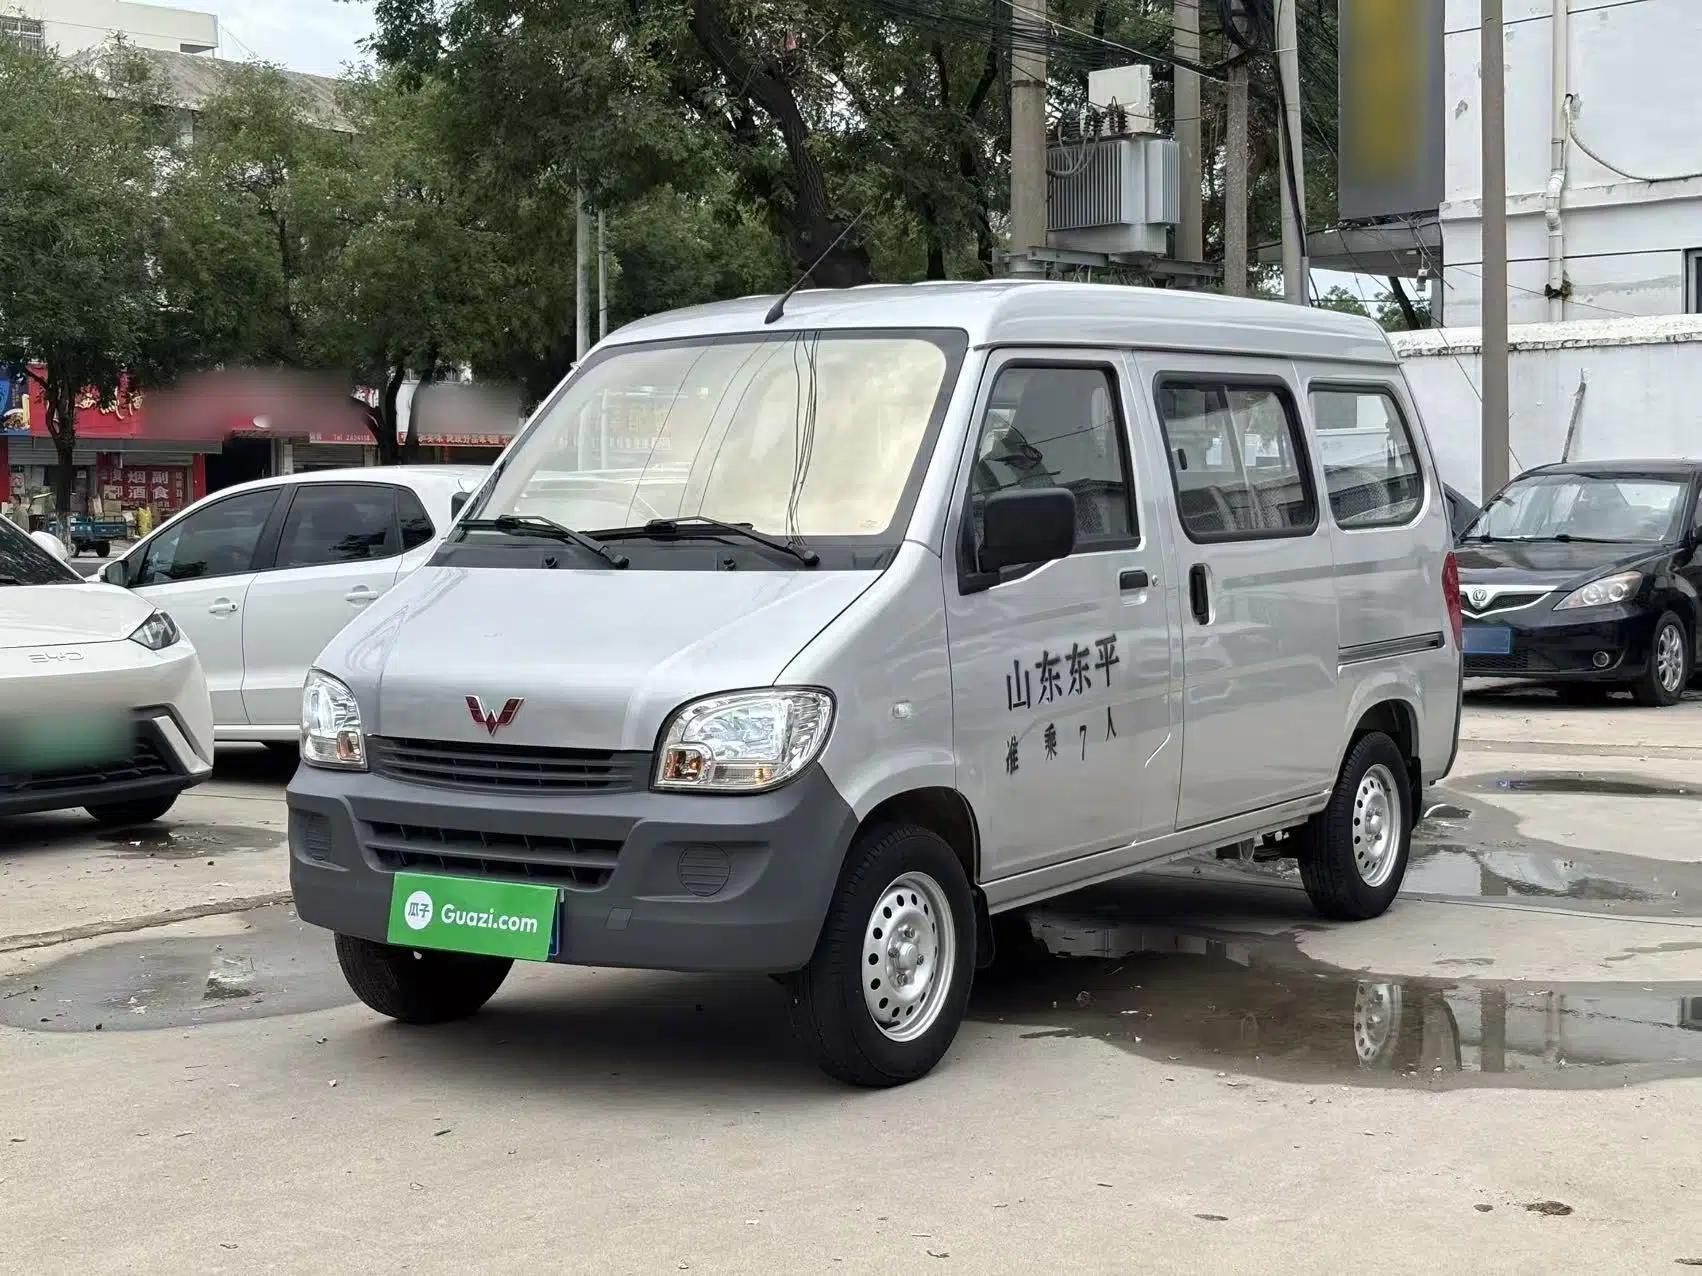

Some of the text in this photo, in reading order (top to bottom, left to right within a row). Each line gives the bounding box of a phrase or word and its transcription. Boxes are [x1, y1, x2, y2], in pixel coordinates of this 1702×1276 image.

[1006, 633, 1120, 711] 山东东平
[408, 902, 538, 933] 瓜子 Guazi.com
